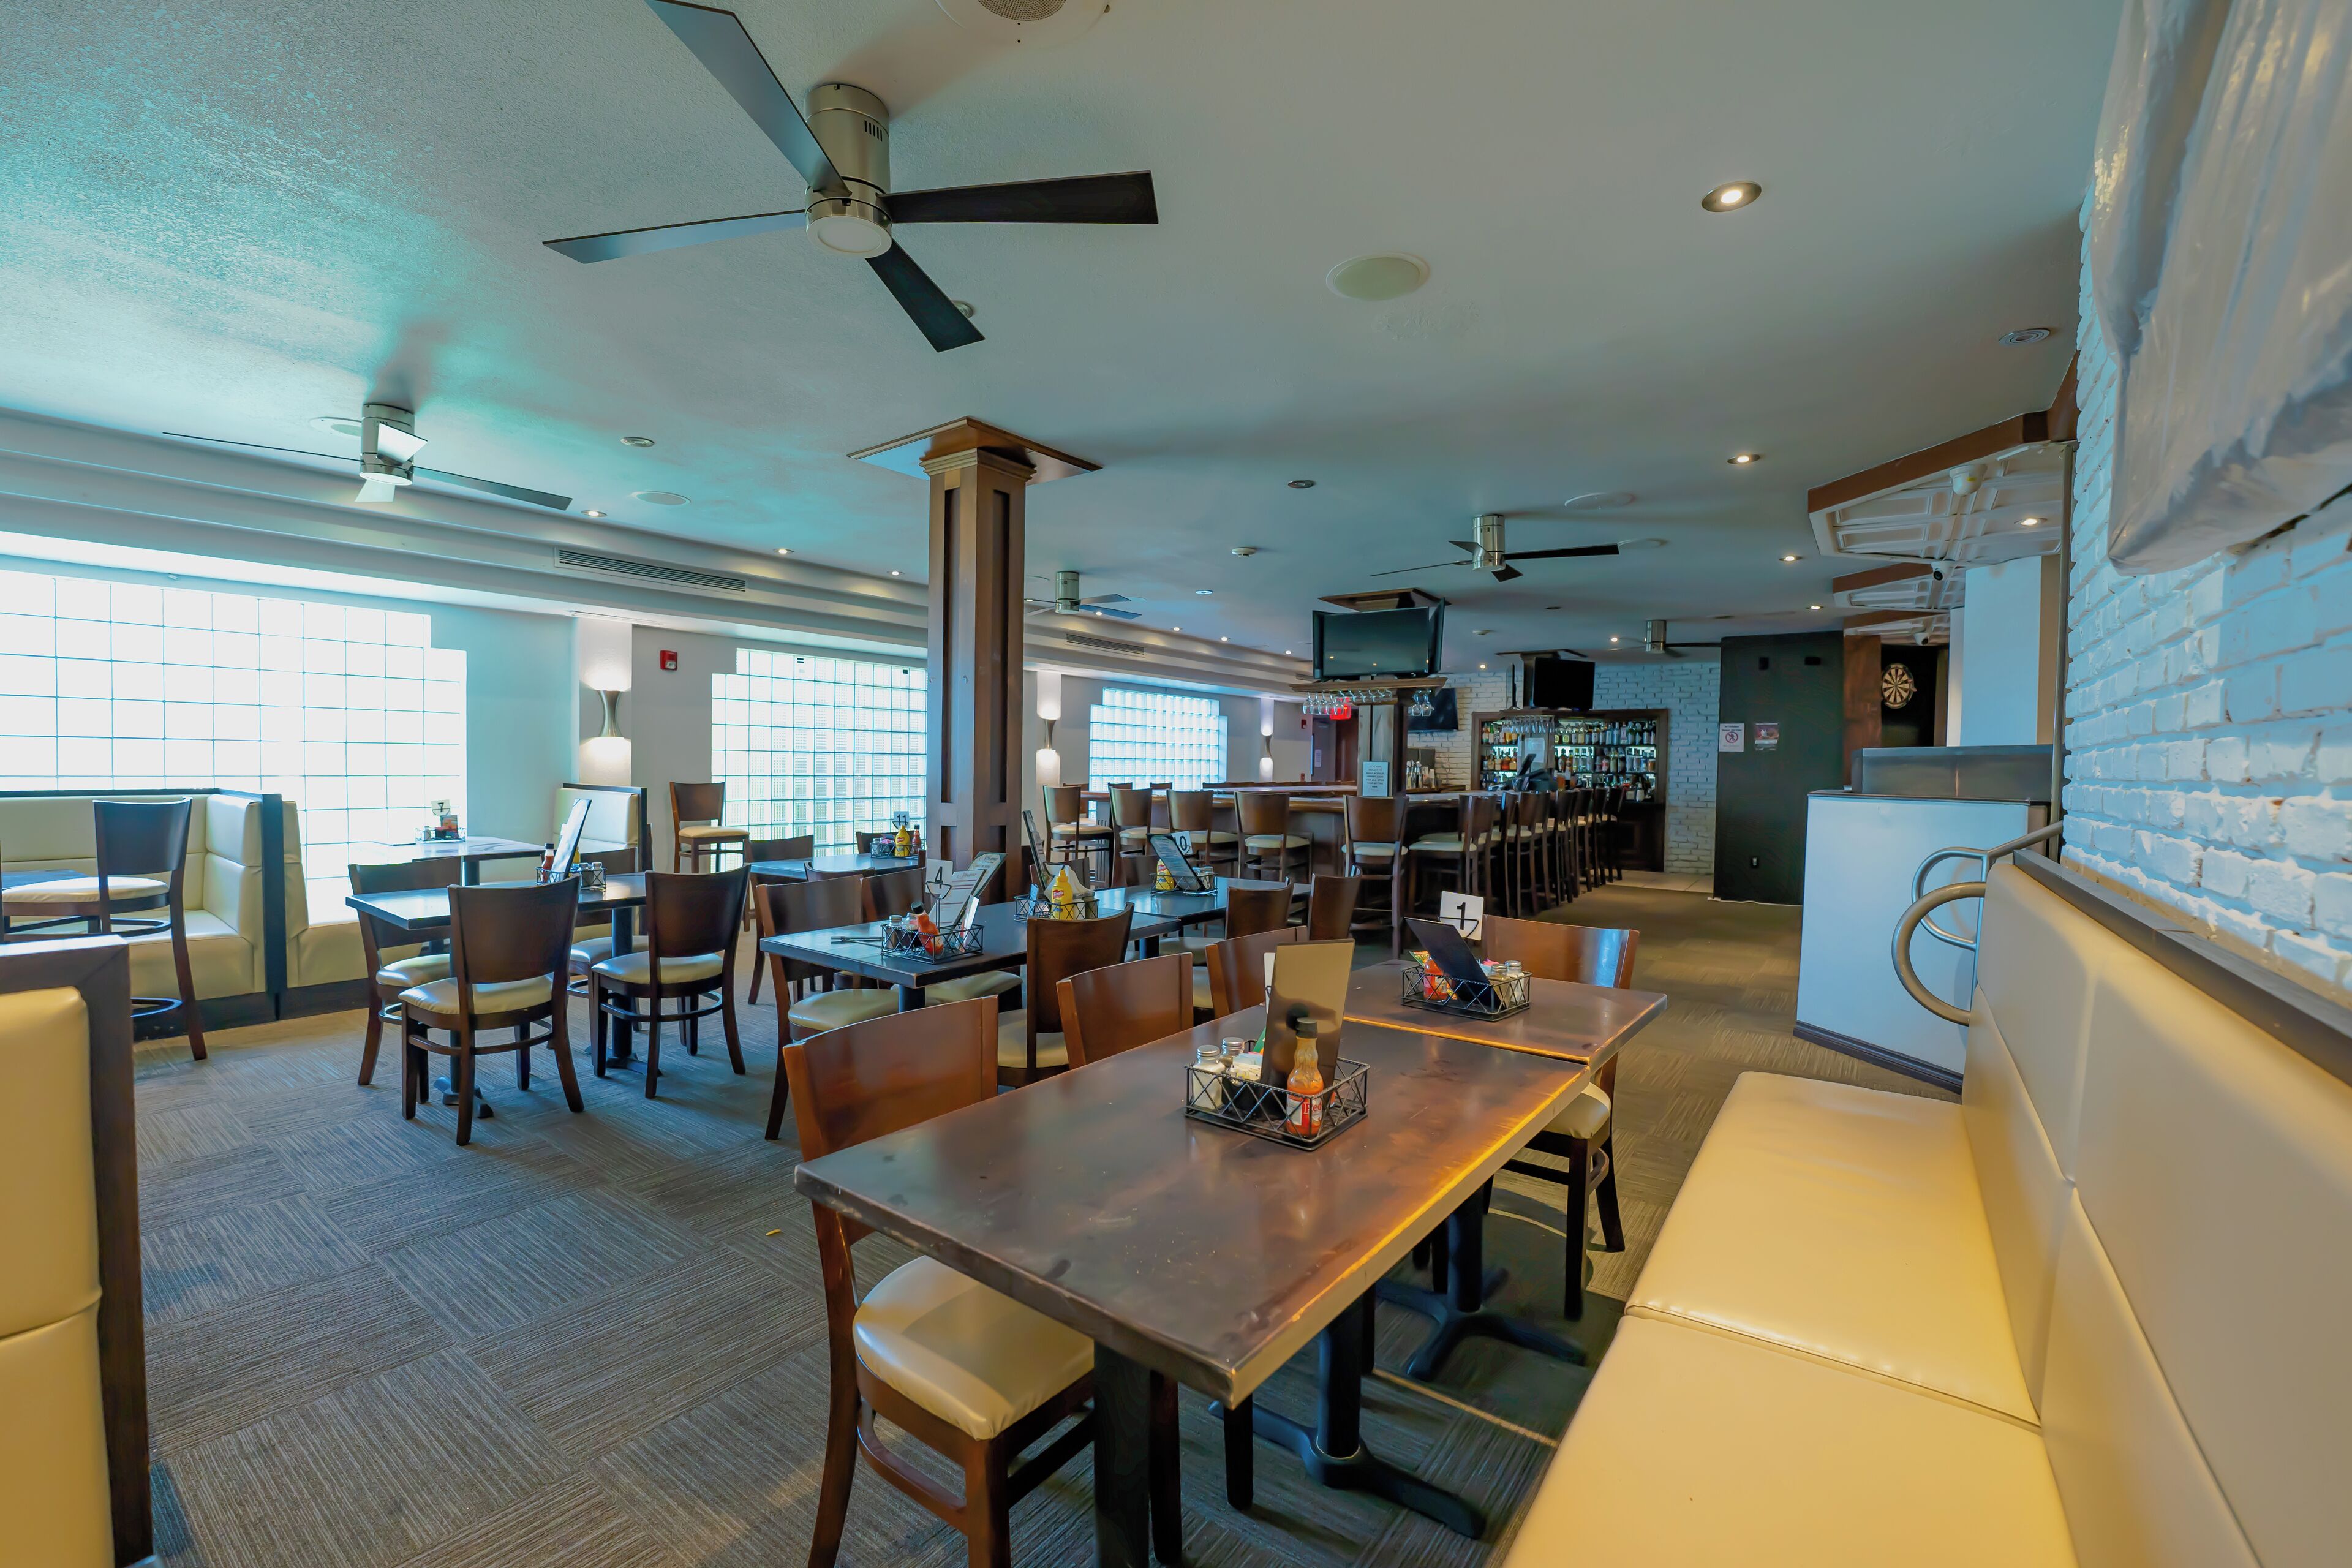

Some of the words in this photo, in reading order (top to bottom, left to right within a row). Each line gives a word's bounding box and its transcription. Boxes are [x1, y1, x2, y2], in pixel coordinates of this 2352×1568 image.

[438, 802, 444, 812] 7
[897, 814, 907, 826] 11
[935, 866, 944, 889] 4
[1457, 902, 1466, 930] 1
